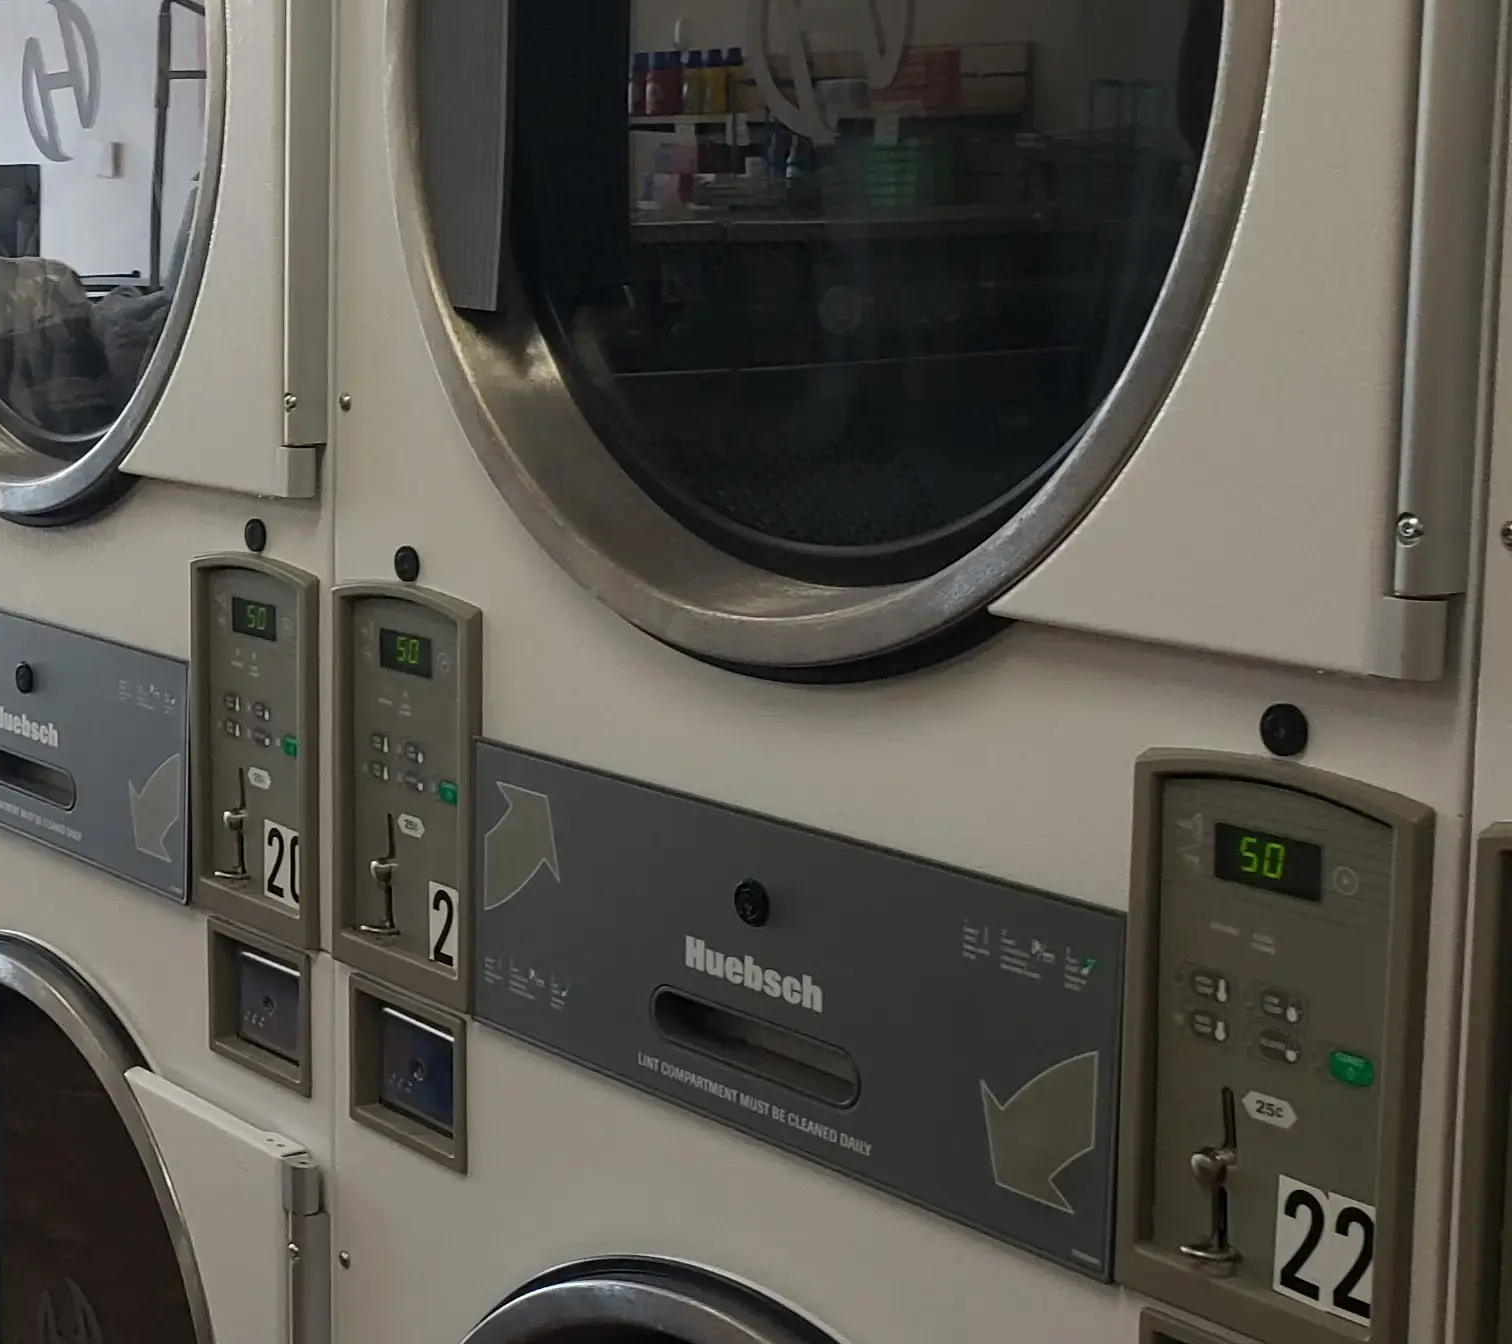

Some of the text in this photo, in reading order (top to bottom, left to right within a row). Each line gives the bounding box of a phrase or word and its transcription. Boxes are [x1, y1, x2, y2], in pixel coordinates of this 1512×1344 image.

[246, 604, 267, 630] 50
[396, 636, 420, 664] 50
[1240, 836, 1285, 879] 50
[685, 935, 824, 1013] Huebsch
[637, 1052, 872, 1157] LINT COMPARTMENT MUST BE CLEANED DAILY
[1279, 1188, 1376, 1320] 22
